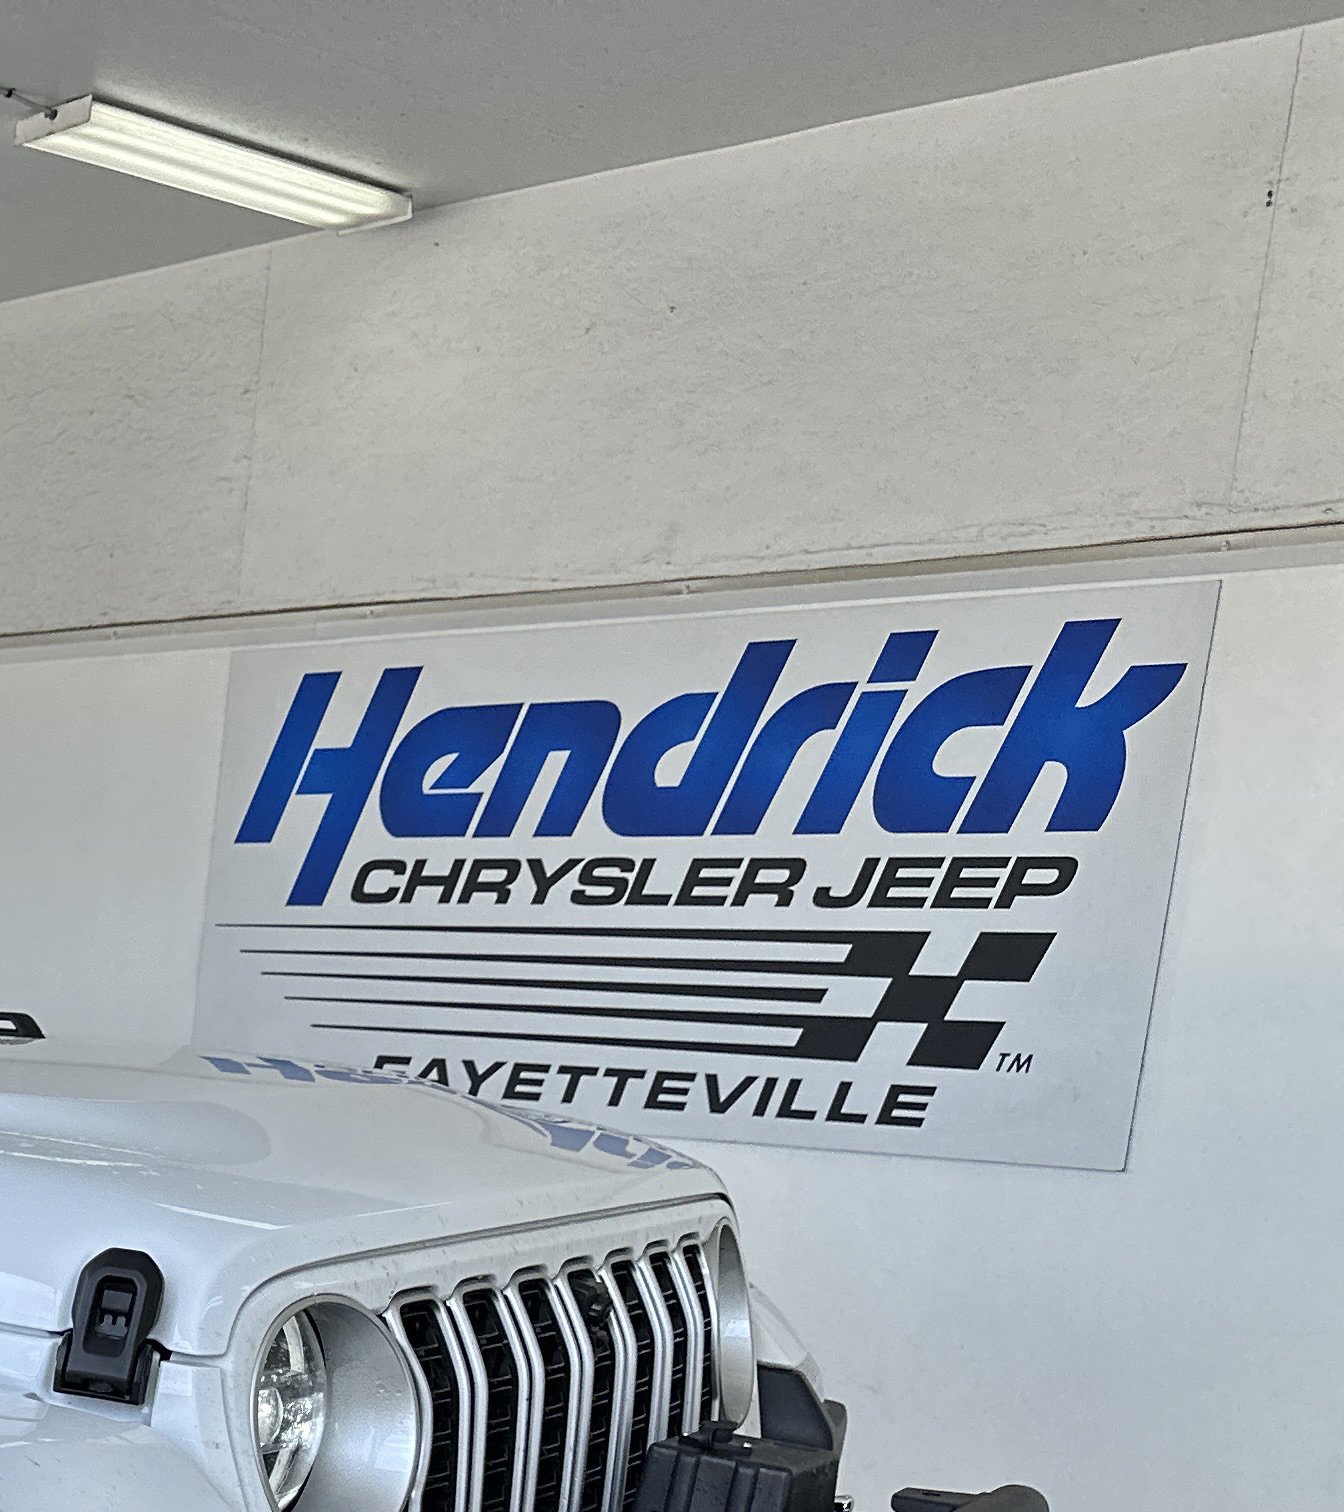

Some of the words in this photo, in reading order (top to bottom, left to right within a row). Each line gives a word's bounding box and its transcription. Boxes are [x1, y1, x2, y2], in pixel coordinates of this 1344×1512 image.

[235, 617, 1188, 906] Hendrick
[349, 856, 807, 908] CHRYSLER
[812, 855, 1079, 909] JEEP
[995, 1052, 1033, 1074] TM
